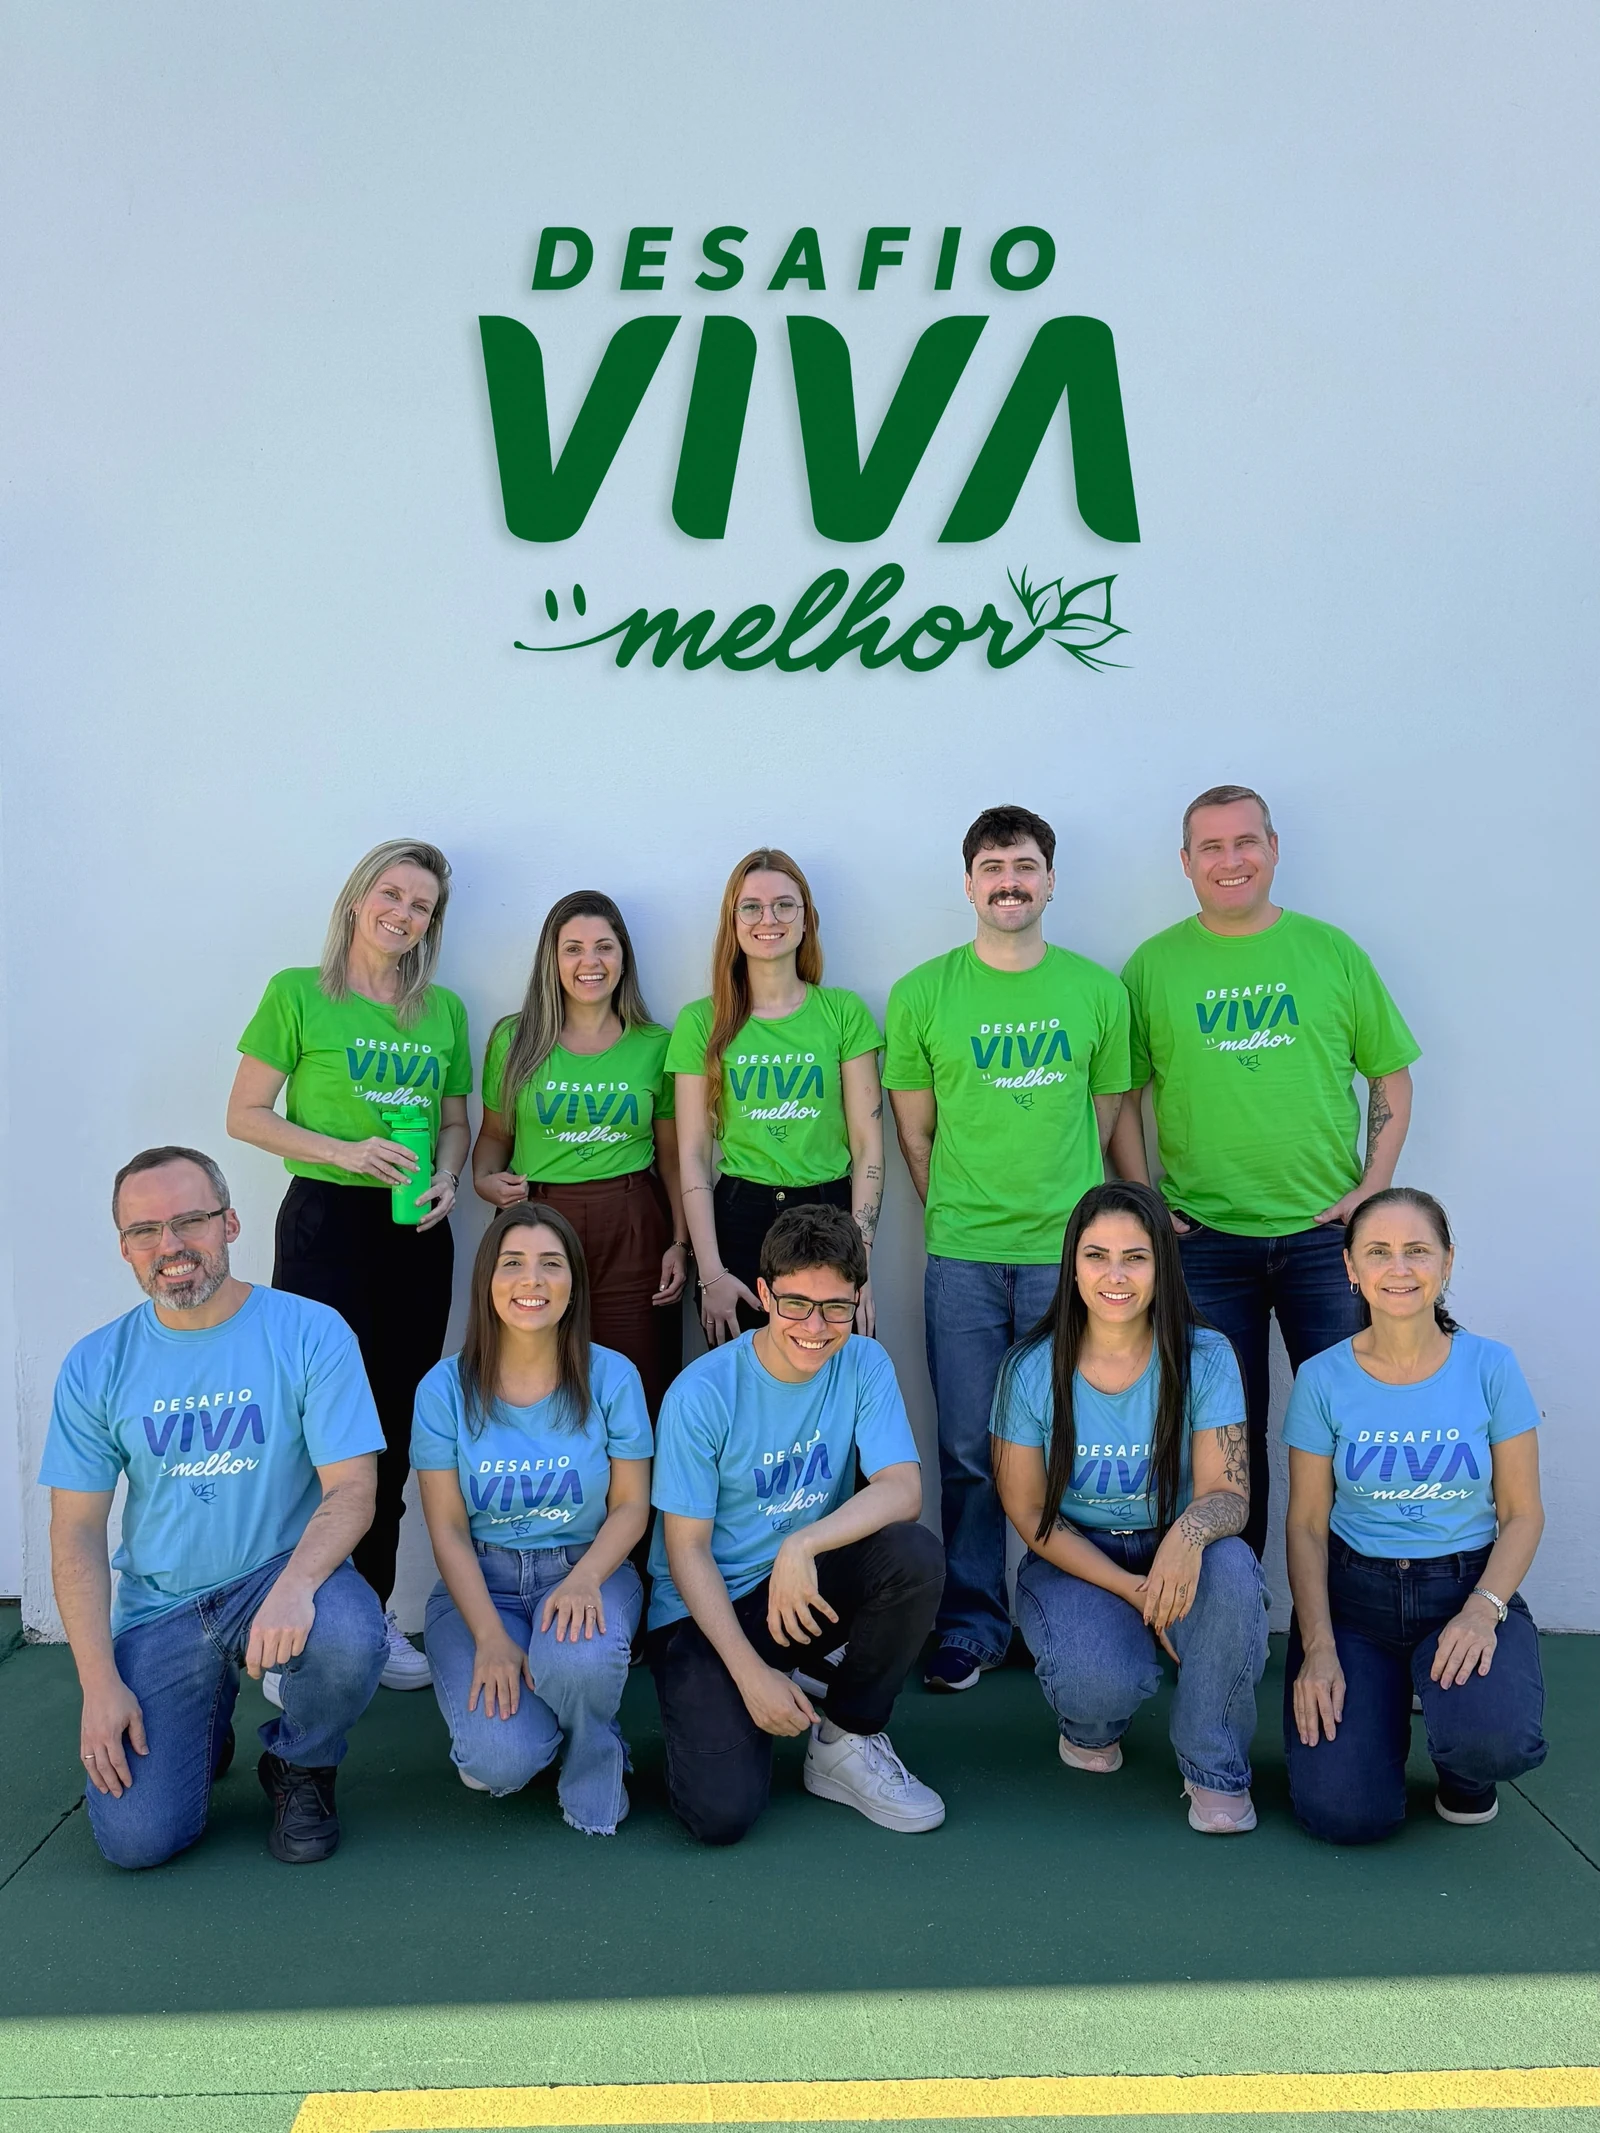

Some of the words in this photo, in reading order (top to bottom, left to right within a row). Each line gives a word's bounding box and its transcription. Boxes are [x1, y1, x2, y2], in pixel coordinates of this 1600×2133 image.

[532, 226, 1056, 291] DESAFIO
[478, 315, 1141, 543] VIVA
[602, 563, 1045, 672] melhor
[1206, 982, 1287, 1000] DESAFIO
[980, 1018, 1060, 1034] DESAFIO
[1196, 994, 1300, 1034] VIVA
[355, 1037, 432, 1054] DESAFIO
[970, 1029, 1073, 1069] VIVA
[1218, 1029, 1296, 1052] melhor
[346, 1047, 441, 1091] VIVA
[737, 1052, 816, 1065] DESAFIO
[546, 1080, 629, 1092] DESAFIO
[729, 1064, 825, 1102] VIVA
[993, 1066, 1068, 1089] melhor
[364, 1087, 432, 1108] melhor
[535, 1092, 639, 1126] VIVA
[749, 1099, 822, 1121] melhor
[557, 1125, 633, 1143] melhor
[153, 1388, 253, 1413] DESAFIO
[142, 1403, 266, 1457] VIVA
[1357, 1428, 1460, 1443] DESAFIO
[763, 1429, 820, 1465] DEAFO
[1077, 1444, 1150, 1457] DESAFI
[170, 1450, 260, 1477] melhor
[479, 1455, 570, 1474] DESAFIO
[1345, 1442, 1481, 1483] VIVA
[469, 1469, 584, 1512] VIVA
[1371, 1482, 1474, 1500] melhor
